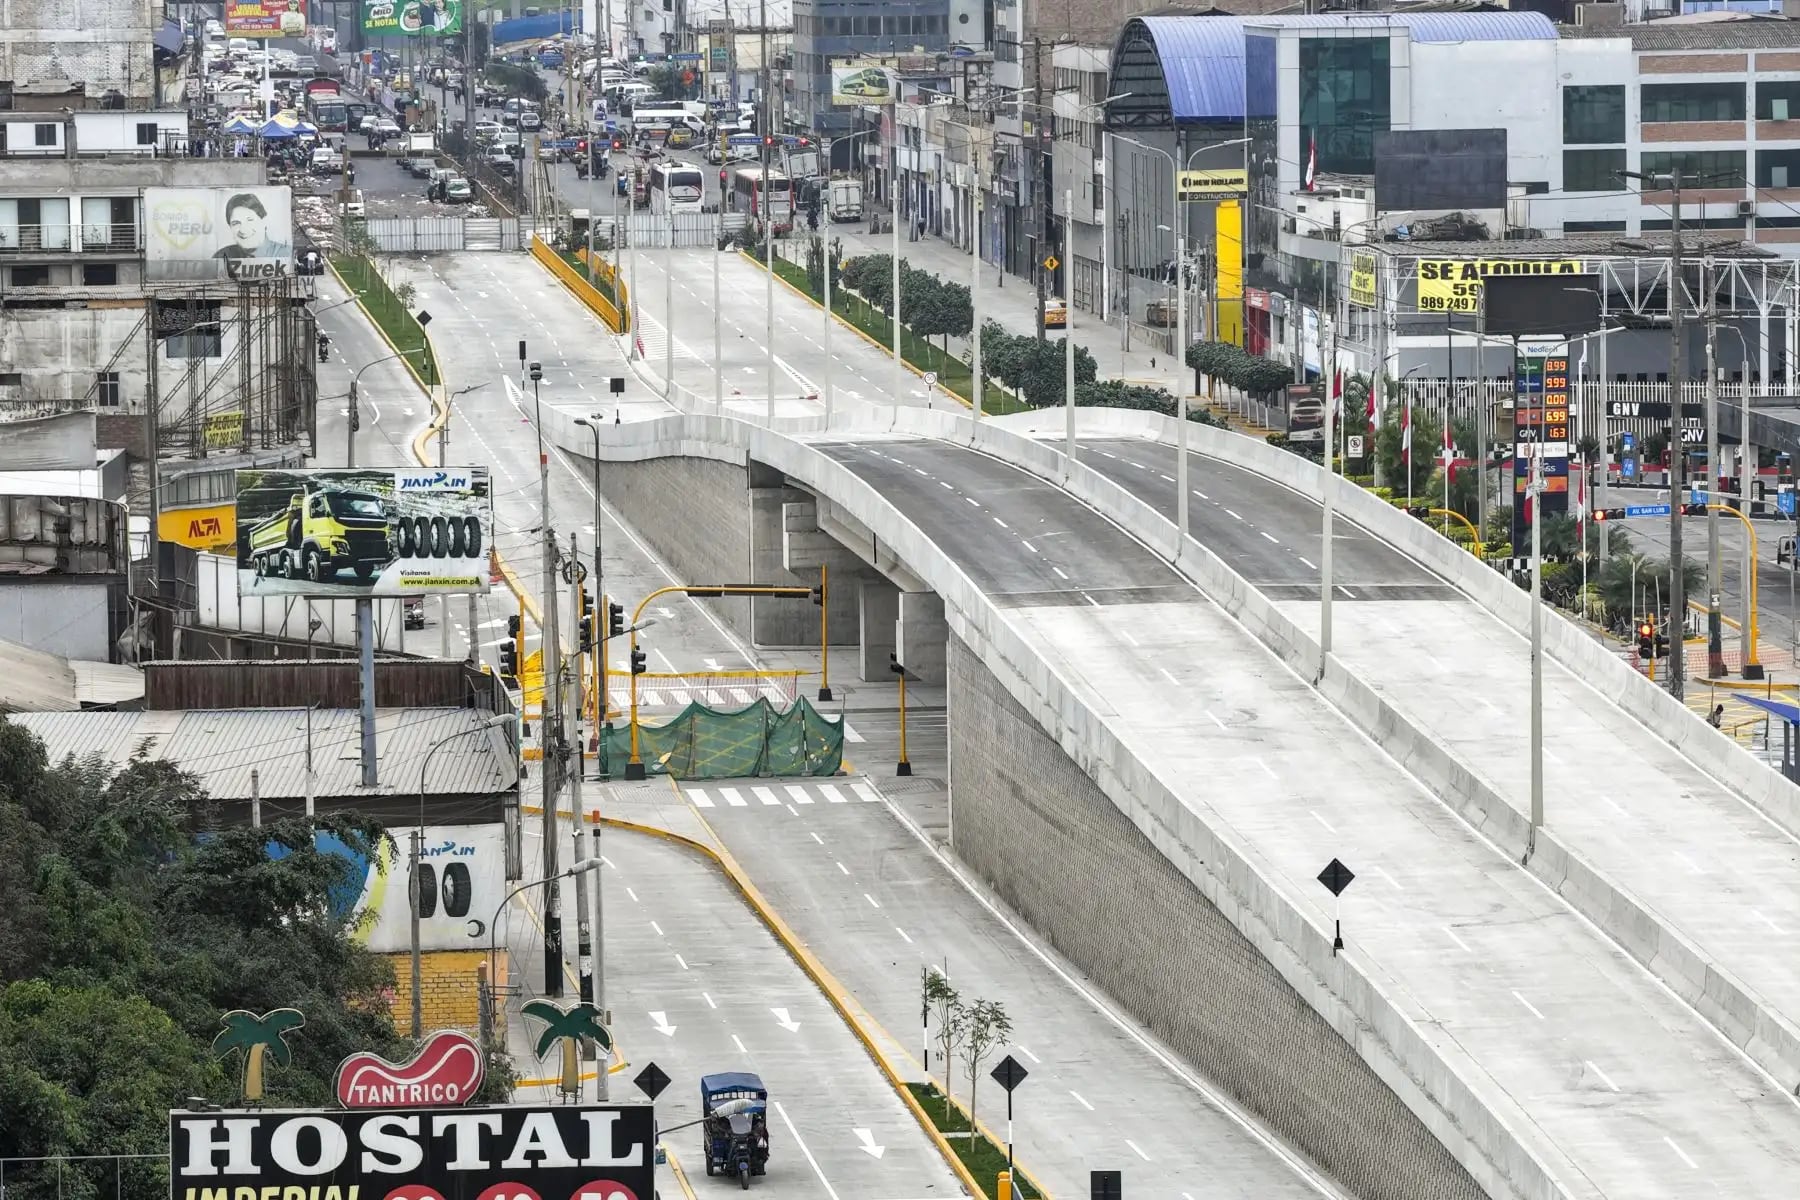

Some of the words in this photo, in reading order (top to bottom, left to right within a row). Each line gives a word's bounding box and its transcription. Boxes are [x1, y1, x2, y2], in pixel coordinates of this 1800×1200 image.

[365, 20, 373, 28] SE
[374, 18, 398, 26] NOTAN
[229, 260, 286, 278] Zurek
[1421, 262, 1454, 280] SE
[1421, 297, 1444, 309] 989
[1447, 297, 1469, 310] 249
[1613, 402, 1640, 416] GNV
[1519, 429, 1536, 437] GNV
[1681, 429, 1704, 442] GNV
[402, 472, 466, 488] JIANXIN
[416, 841, 475, 856] ANXIN
[355, 1082, 459, 1103] TANTRICO
[180, 1111, 643, 1175] HOSTAL
